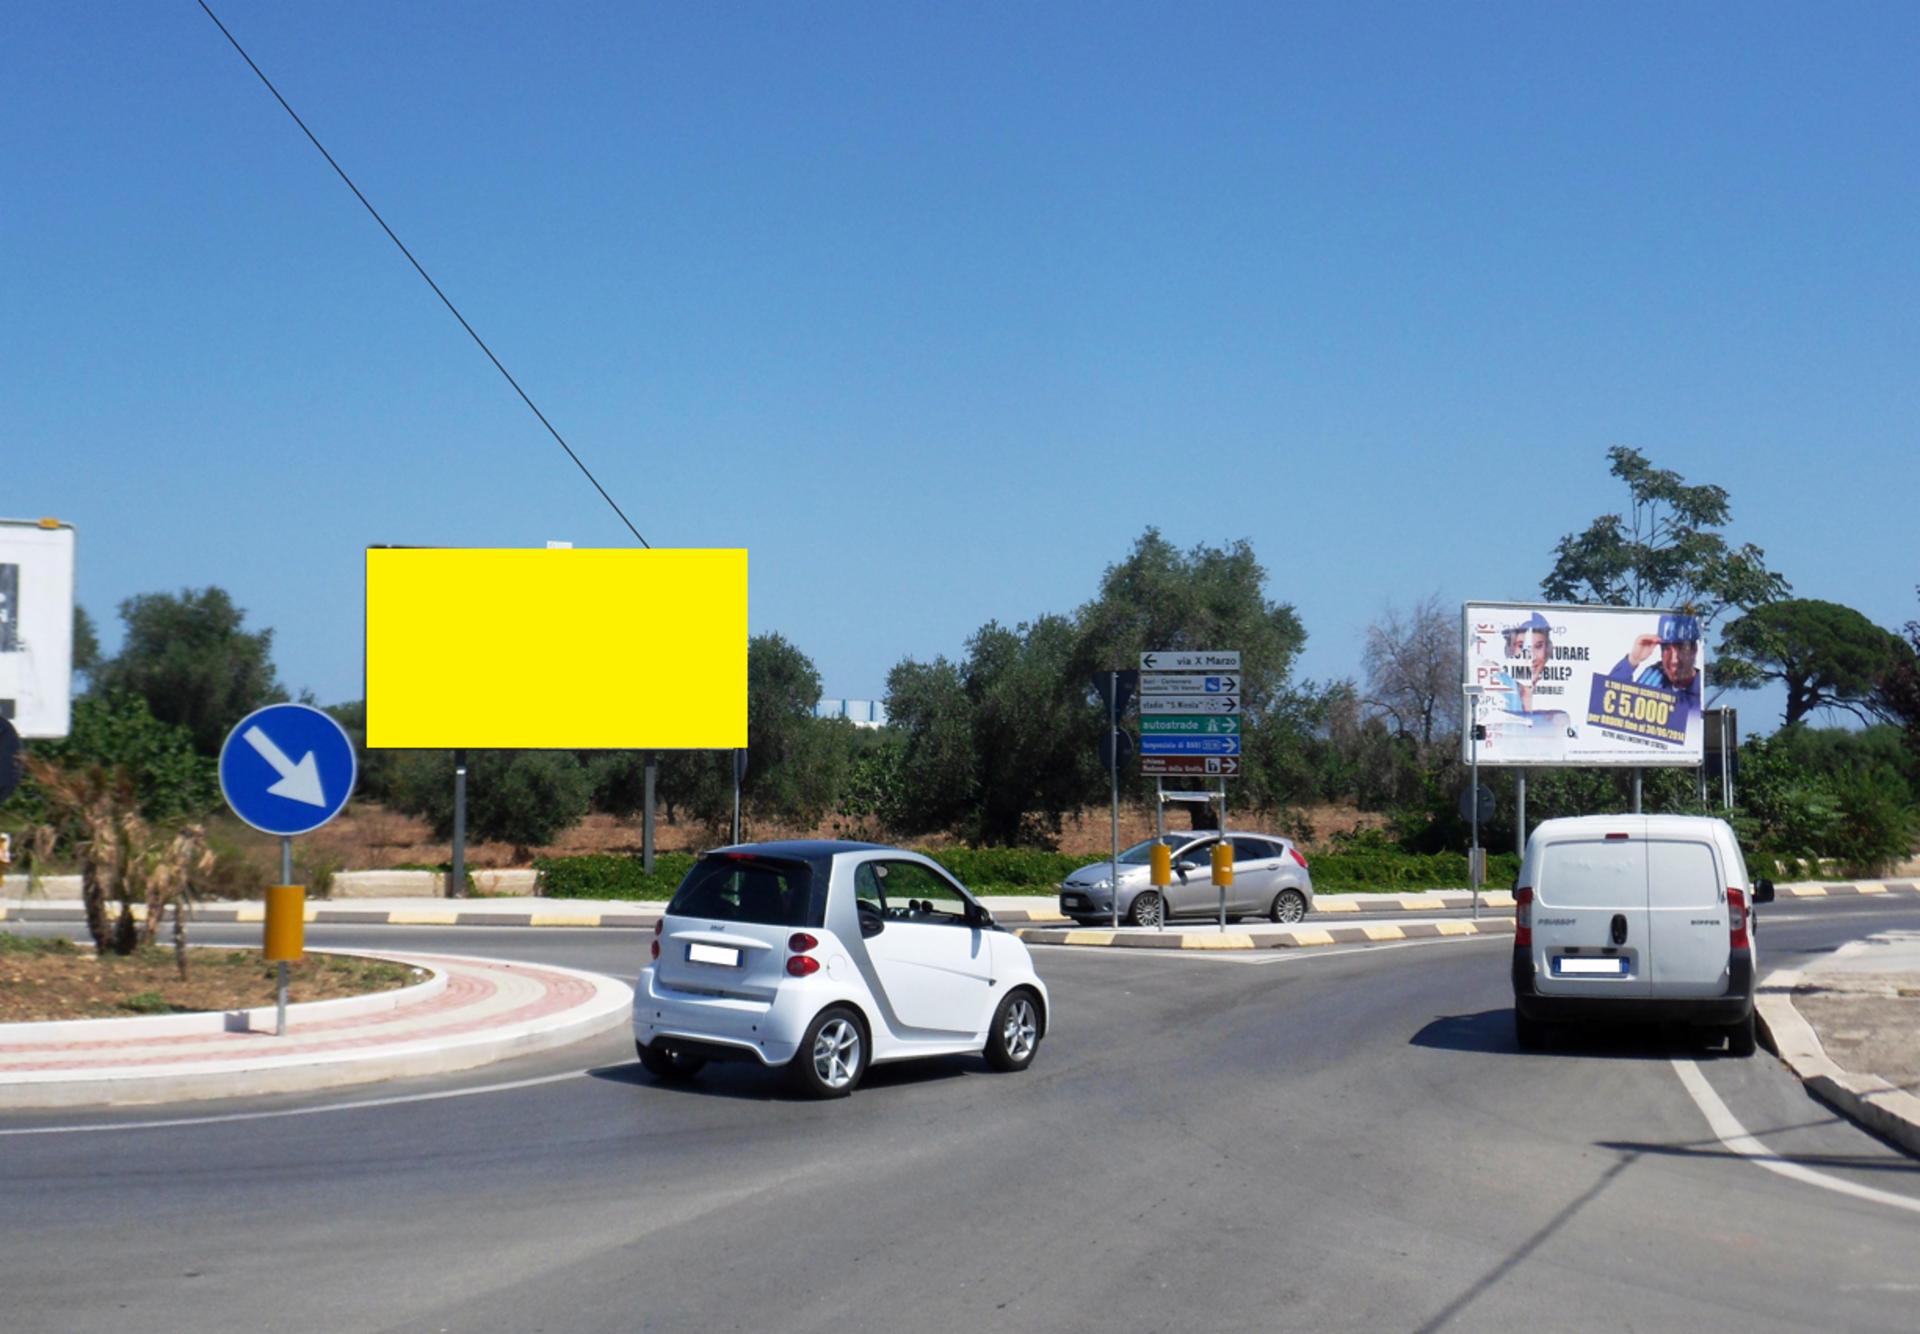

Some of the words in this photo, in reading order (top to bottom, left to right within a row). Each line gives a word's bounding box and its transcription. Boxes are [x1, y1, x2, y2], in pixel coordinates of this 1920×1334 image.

[1177, 656, 1192, 665] via
[1195, 656, 1202, 665] X
[1206, 656, 1237, 665] Marzo
[1511, 664, 1573, 681] IMMBILE?
[1603, 690, 1616, 714] €
[1143, 720, 1199, 729] autostrade
[1538, 918, 1577, 926] PEUGEOT
